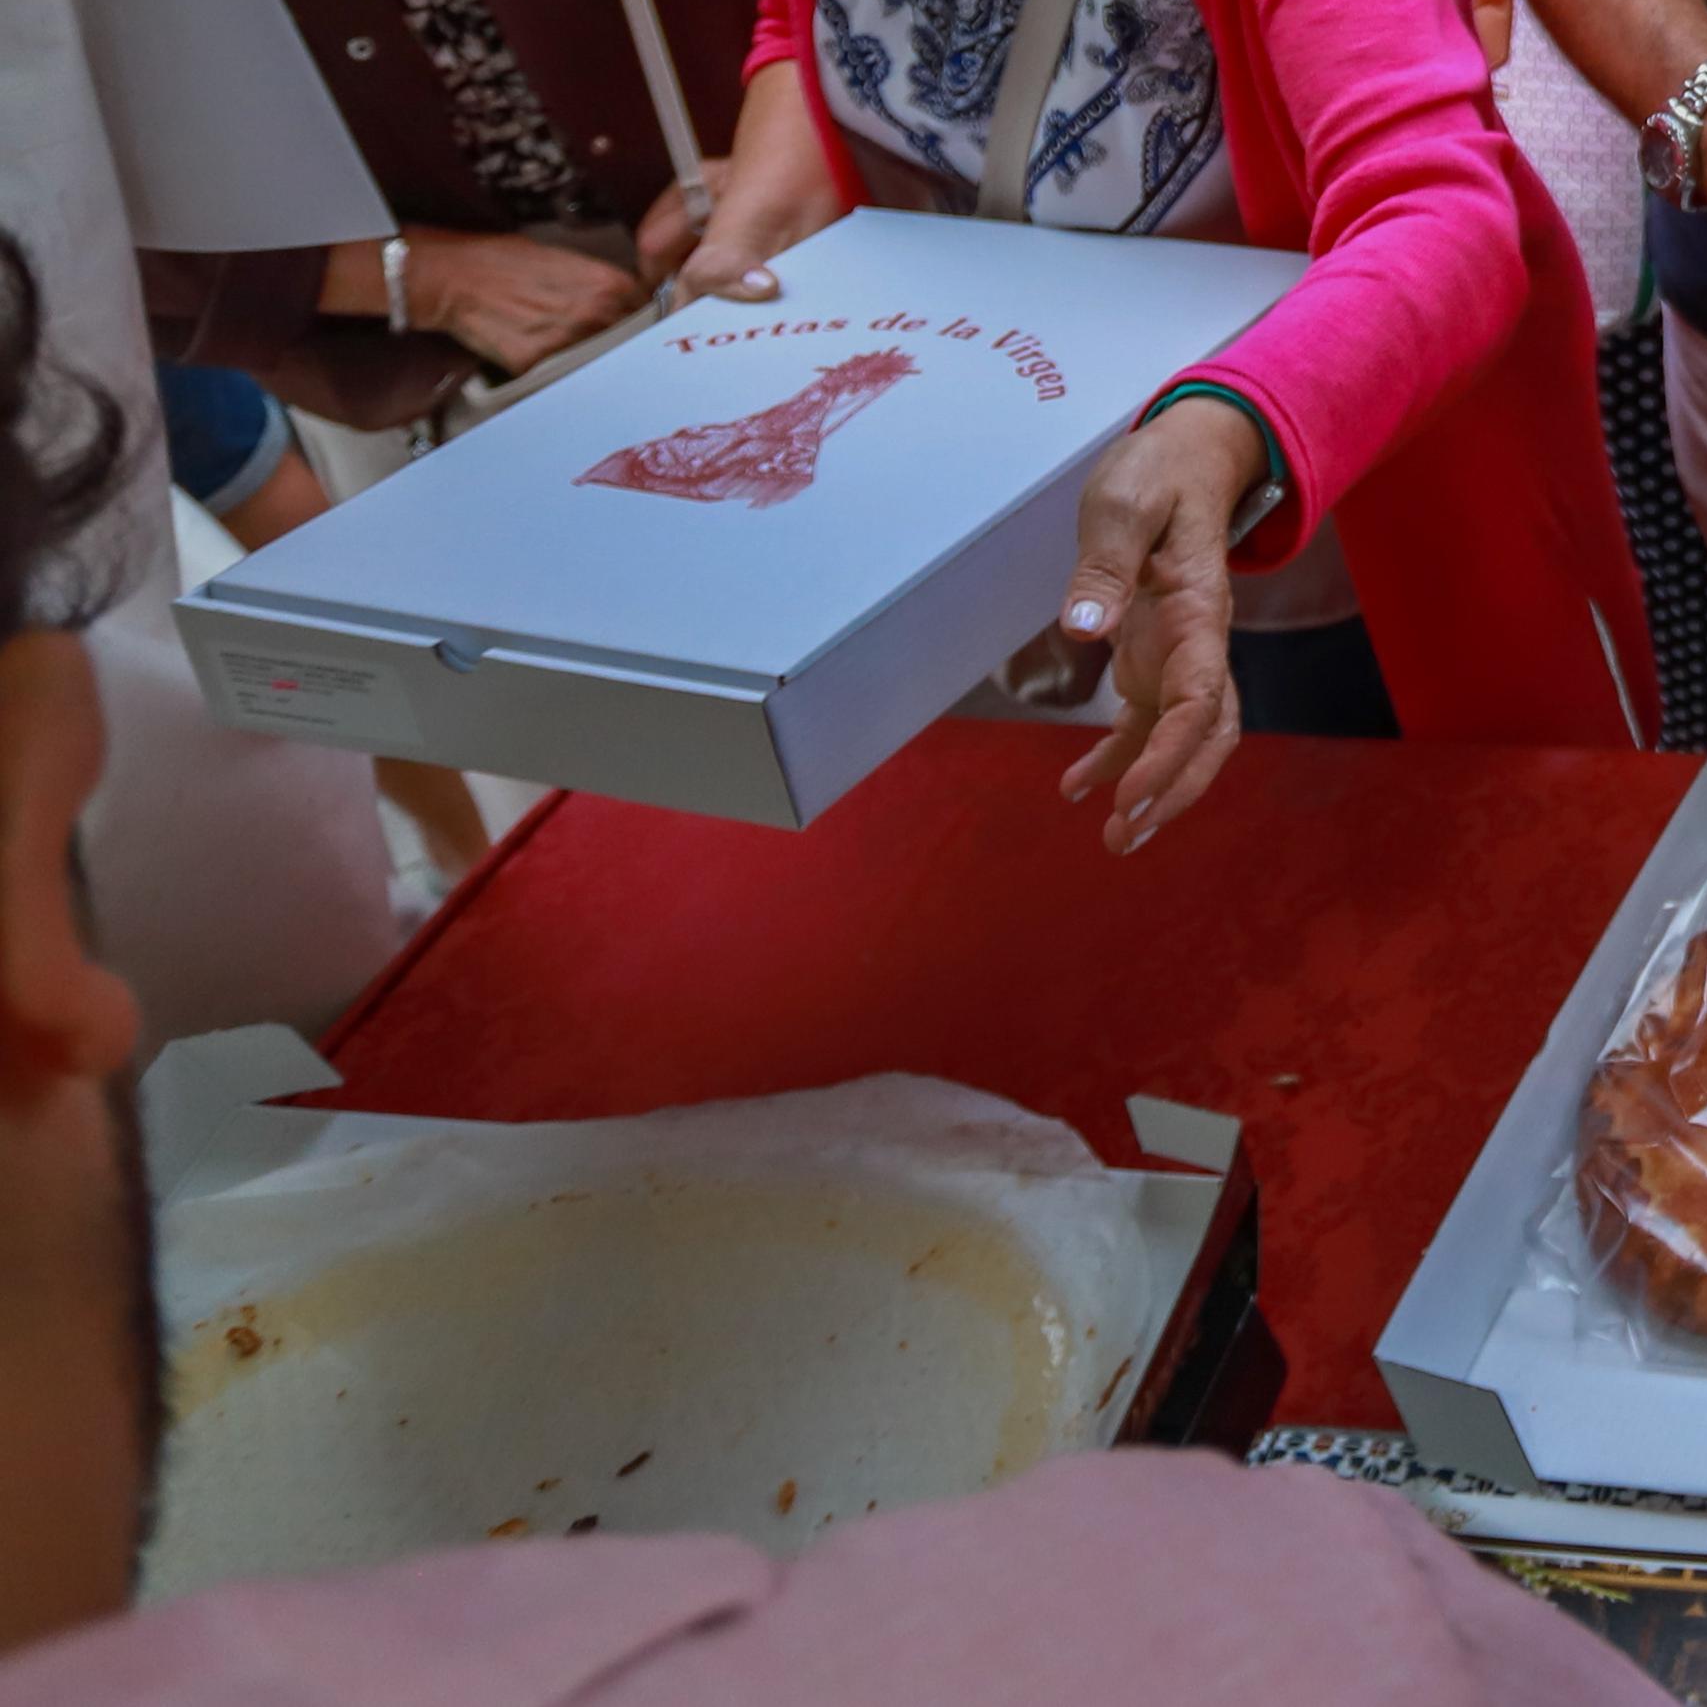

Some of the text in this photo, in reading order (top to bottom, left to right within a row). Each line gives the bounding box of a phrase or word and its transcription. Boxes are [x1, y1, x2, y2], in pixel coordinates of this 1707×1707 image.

[663, 311, 1069, 403] Tortas de la Virgen
